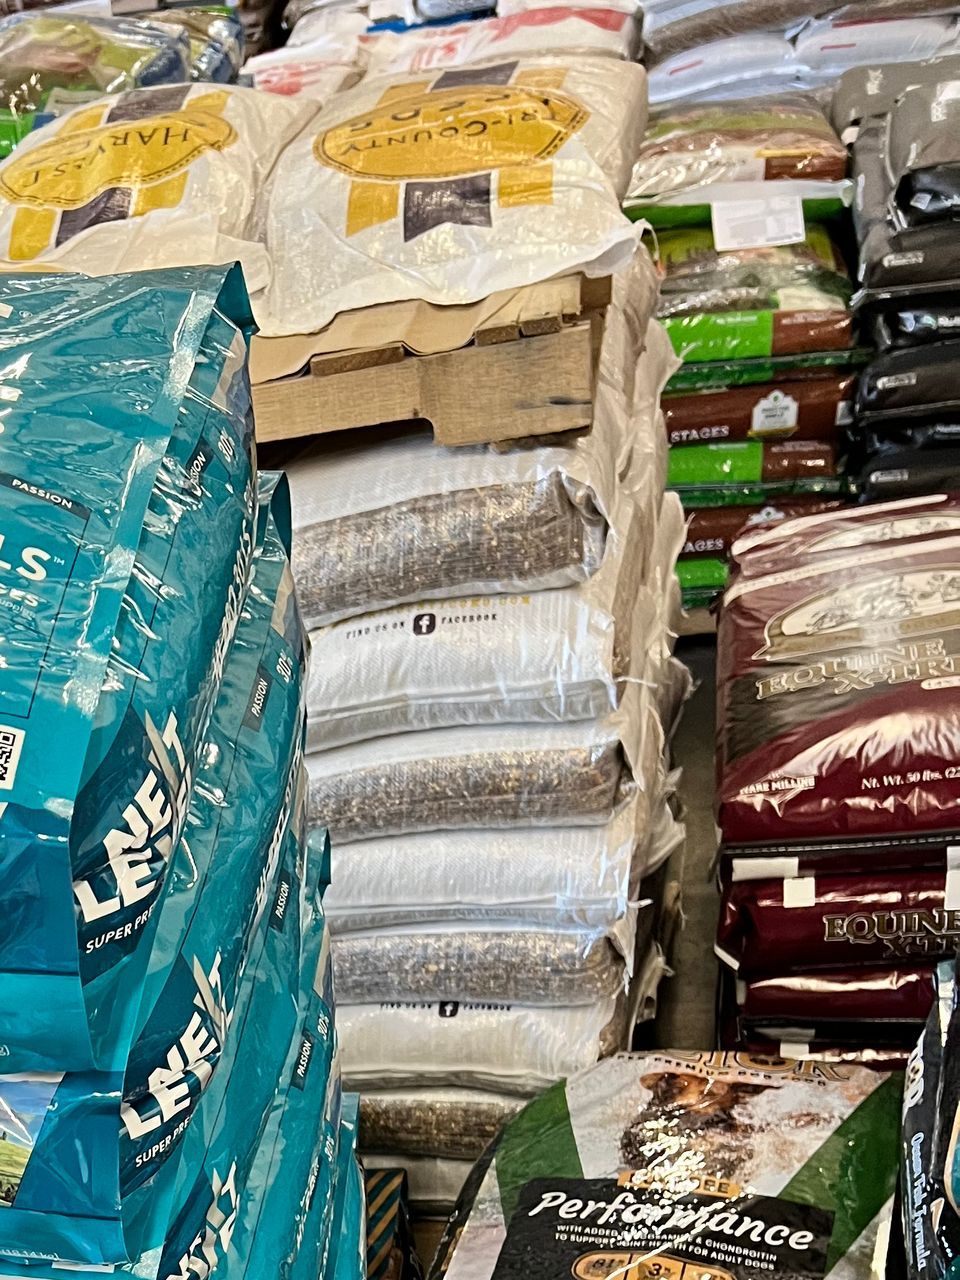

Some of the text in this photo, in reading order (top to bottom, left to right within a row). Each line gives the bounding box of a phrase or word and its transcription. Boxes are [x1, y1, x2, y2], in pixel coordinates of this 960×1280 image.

[10, 478, 73, 510] PASSION
[440, 612, 499, 625] FACEBOOK
[250, 677, 269, 718] PASSION
[823, 906, 960, 944] EQUINE
[528, 1190, 815, 1251] Performance
[556, 1224, 581, 1233] WITH
[583, 1226, 618, 1237] ADDED
[688, 1245, 708, 1256] FOR
[710, 1249, 743, 1265] ADULT
[704, 1238, 778, 1262] CHONDROITIN
